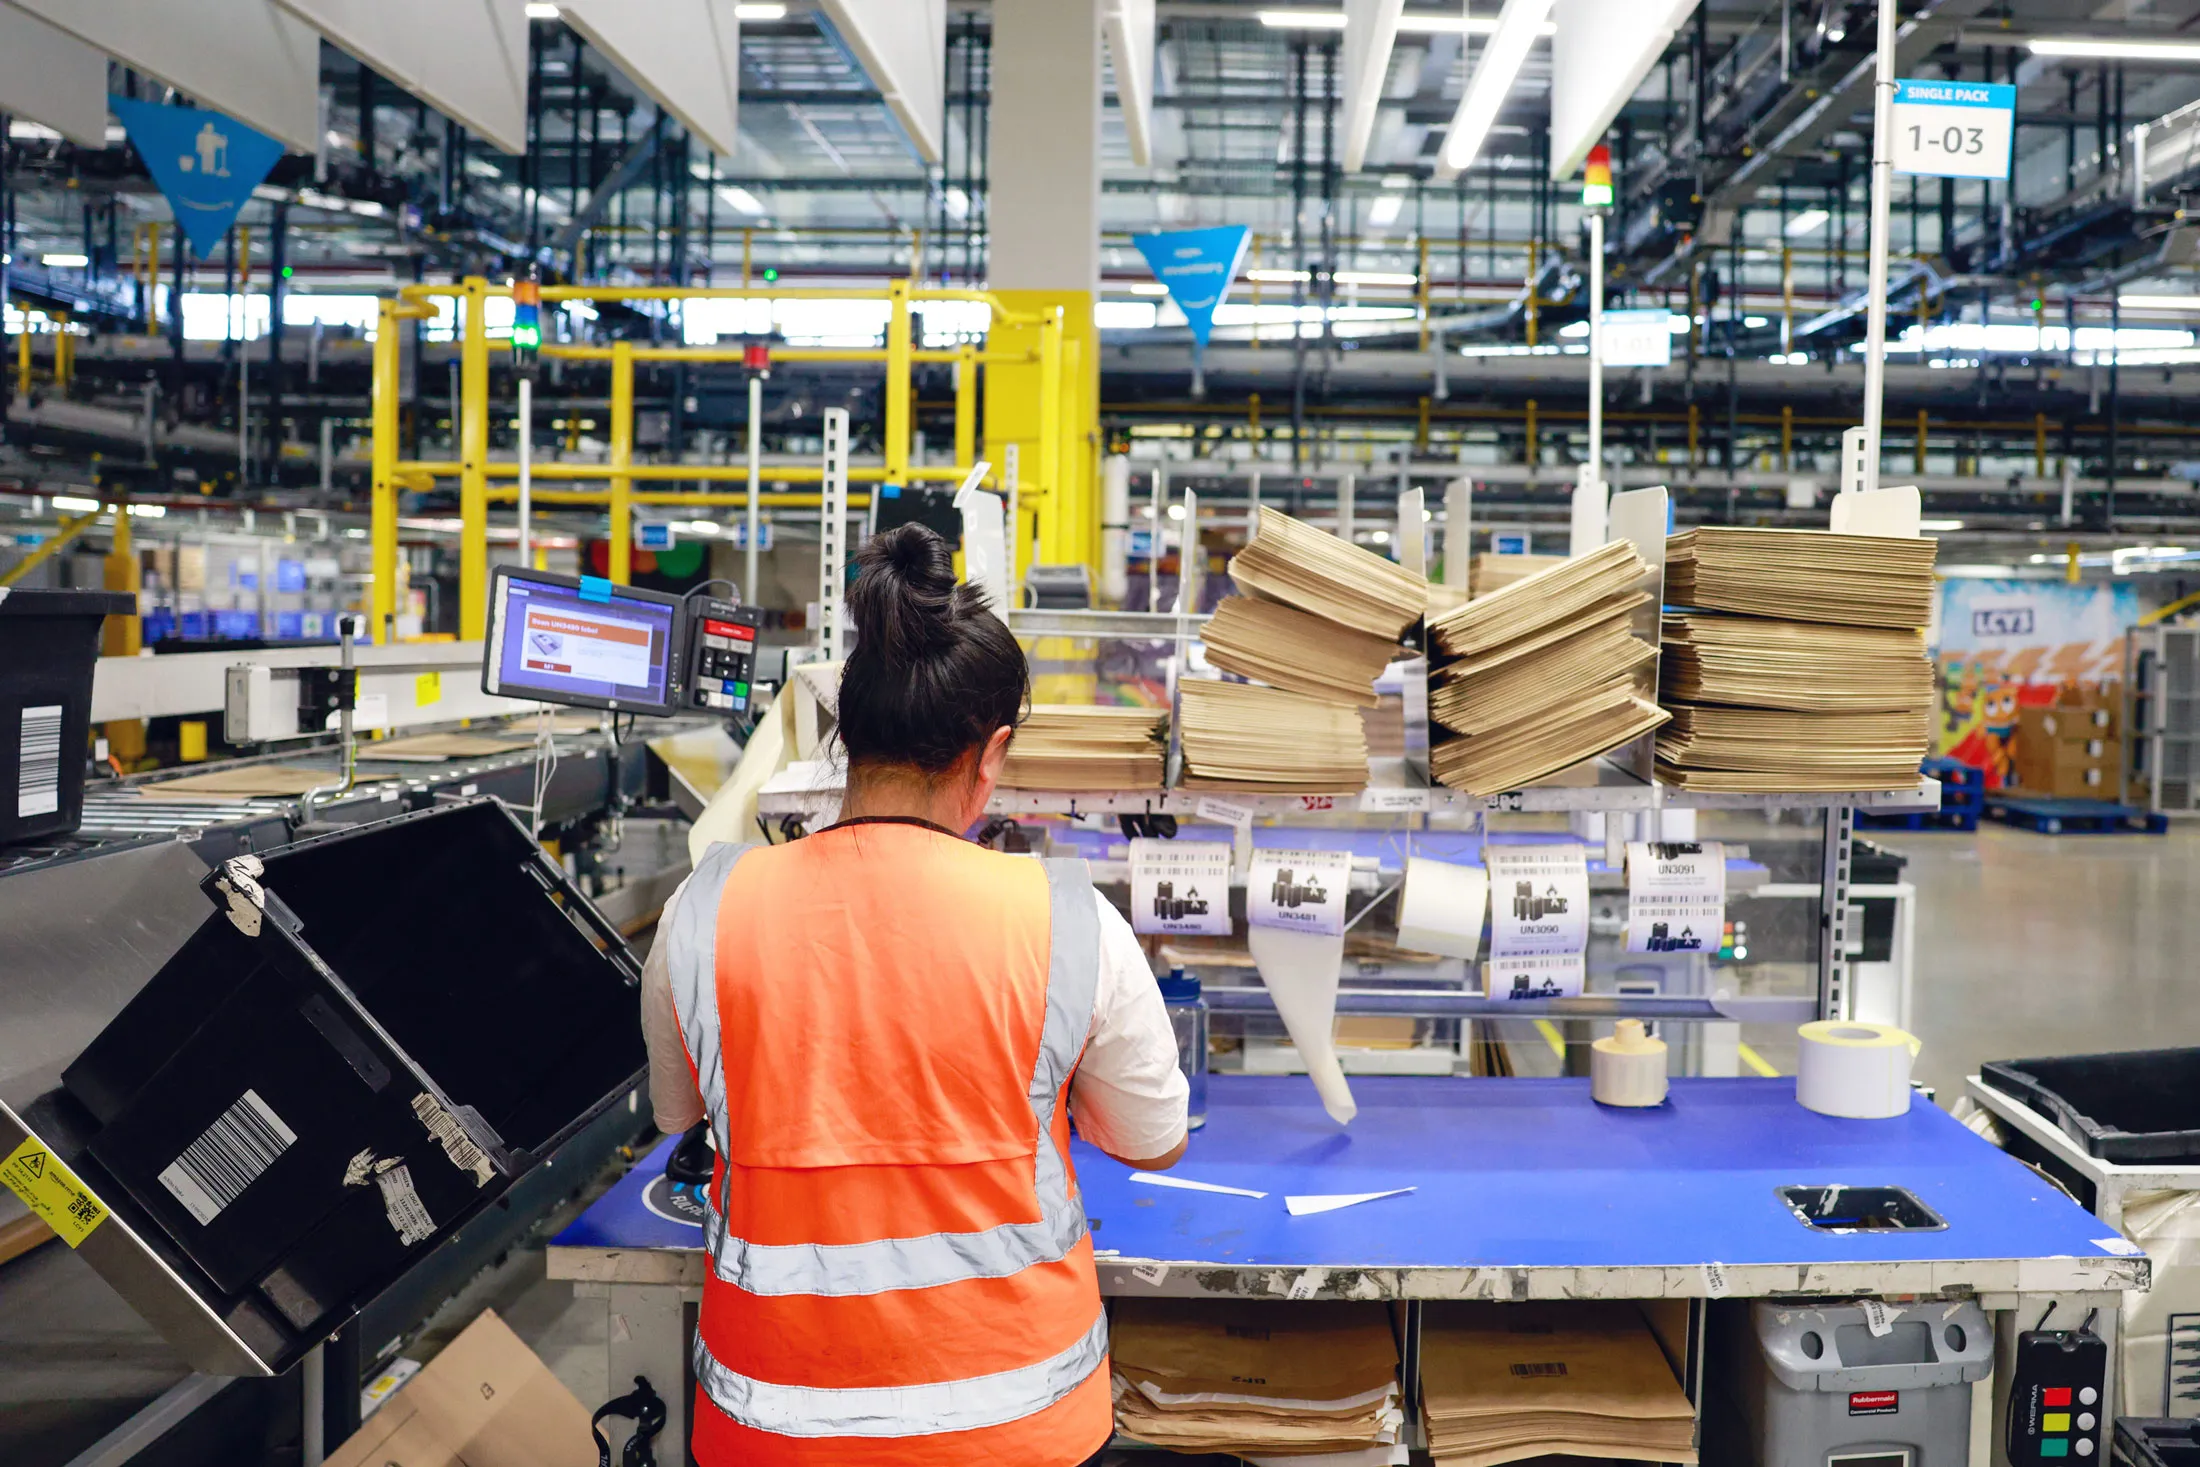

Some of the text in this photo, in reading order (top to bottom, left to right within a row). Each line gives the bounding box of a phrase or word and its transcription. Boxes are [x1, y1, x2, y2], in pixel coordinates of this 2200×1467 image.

[1907, 87, 1989, 102] SINGLE PACK
[1908, 125, 1984, 155] 1-03
[1658, 864, 1696, 875] UN3091
[1278, 911, 1317, 922] UN3481
[1519, 925, 1559, 935] UN3090
[1852, 1394, 1895, 1404] Rubbermaid
[2028, 1383, 2039, 1427] WERMA
